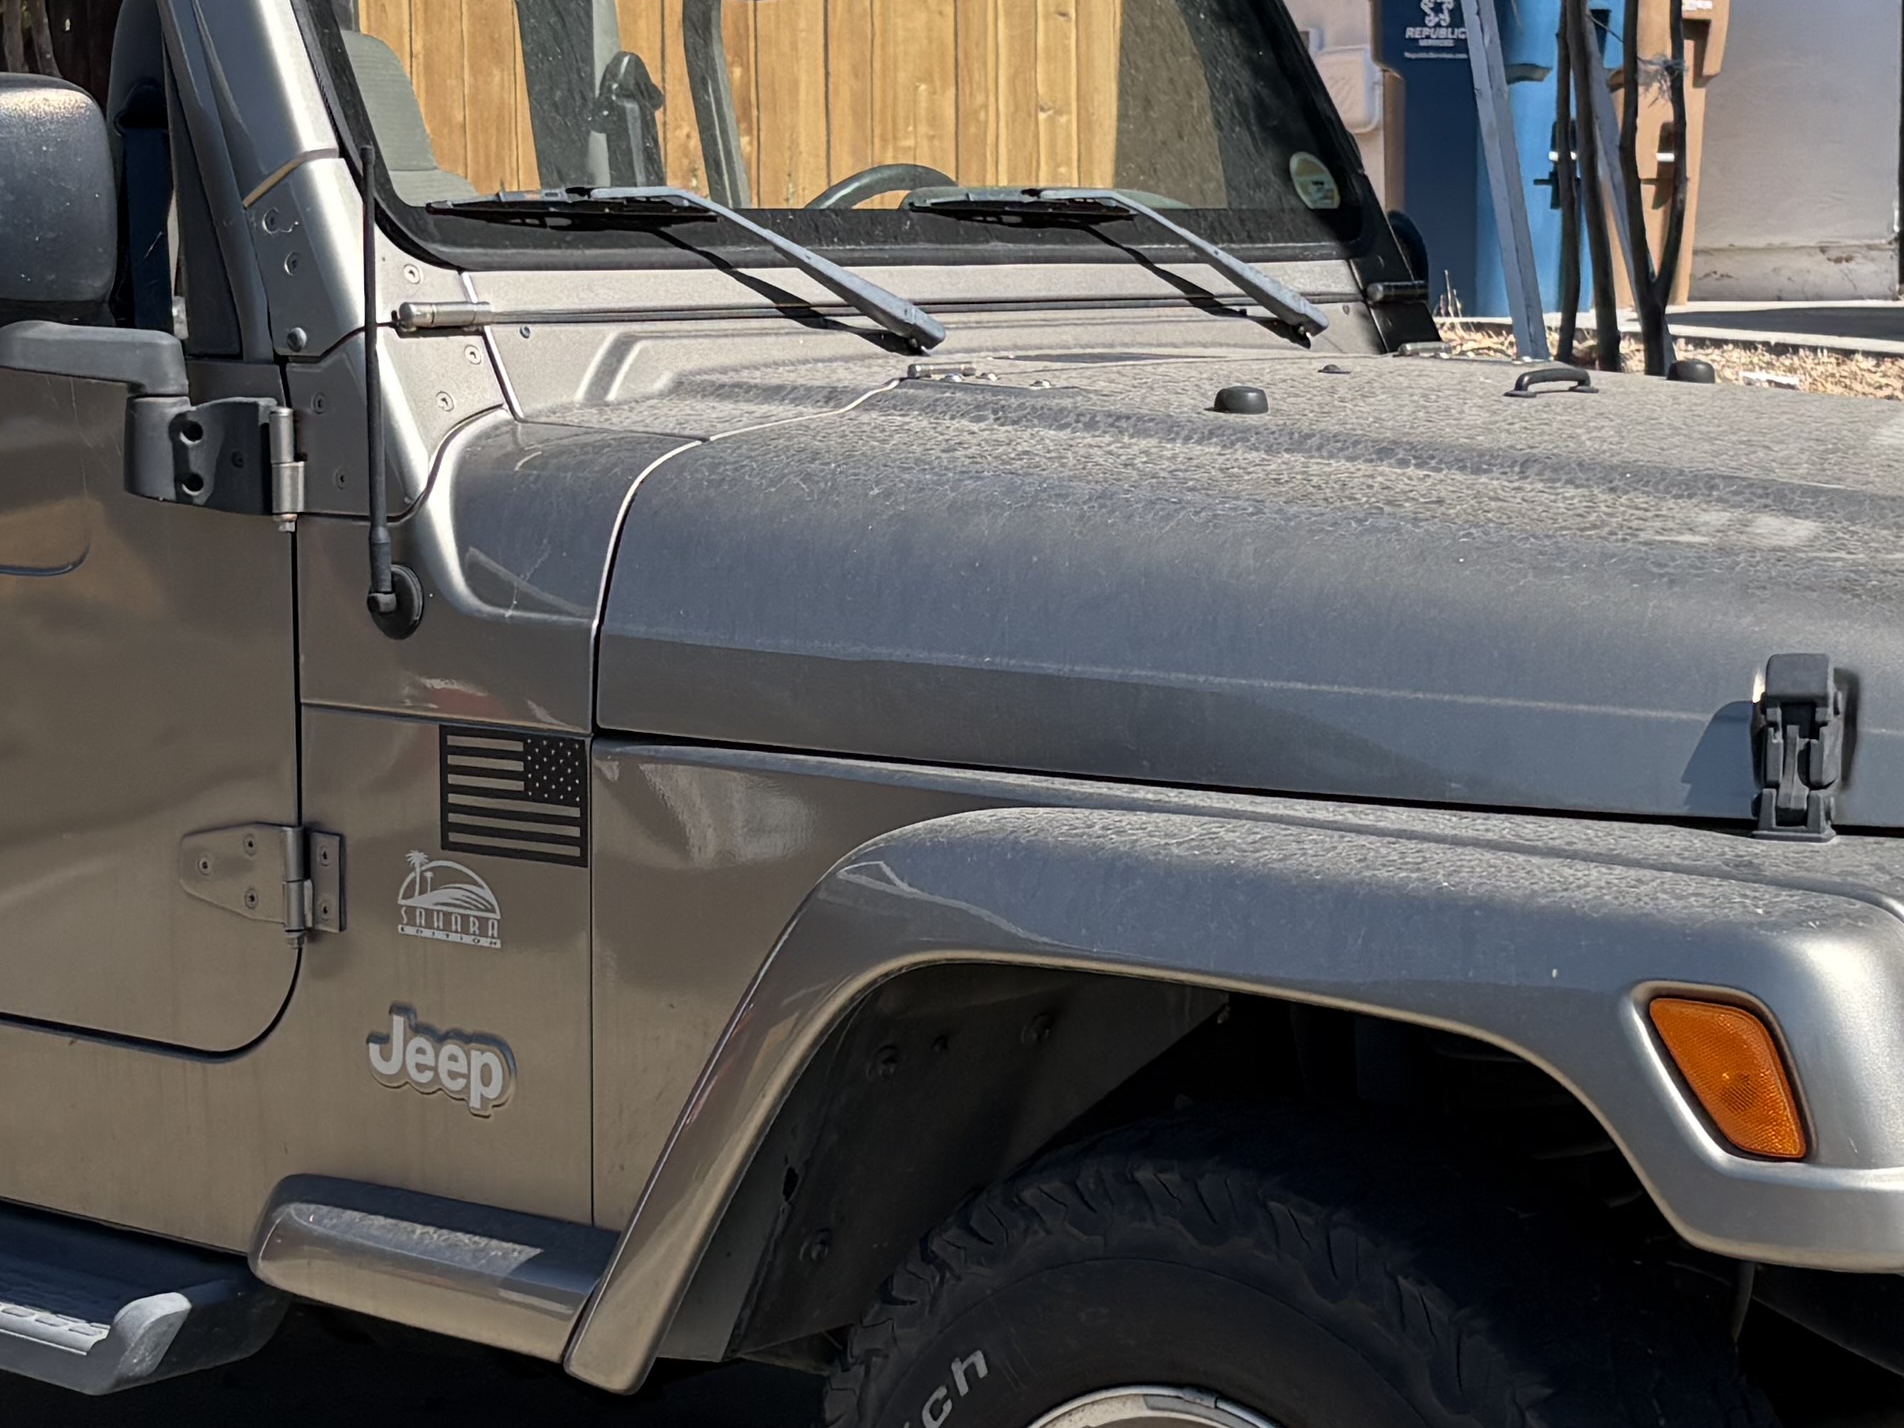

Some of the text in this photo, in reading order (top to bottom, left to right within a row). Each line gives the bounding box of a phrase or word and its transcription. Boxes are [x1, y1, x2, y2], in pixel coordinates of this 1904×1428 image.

[1405, 27, 1467, 39] REPUBLIC
[400, 906, 499, 938] SAHARA
[368, 1013, 503, 1110] Jeep
